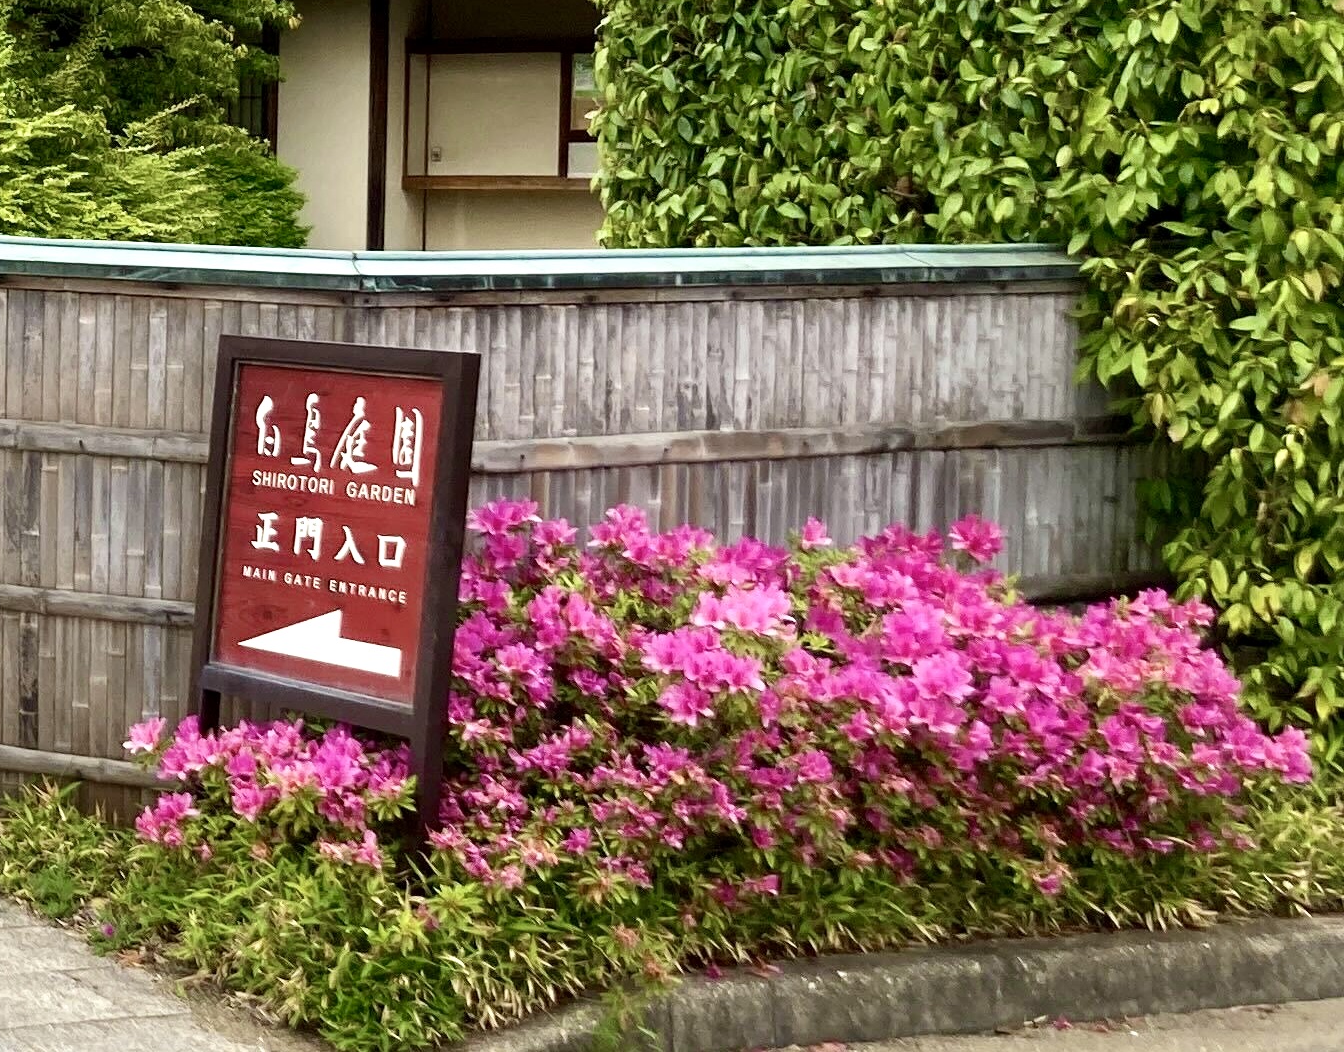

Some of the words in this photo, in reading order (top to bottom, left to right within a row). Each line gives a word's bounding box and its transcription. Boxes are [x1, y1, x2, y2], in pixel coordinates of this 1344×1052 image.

[255, 392, 424, 488] 白鳥庭園
[251, 469, 335, 495] SHIROTORI
[345, 481, 416, 507] GARDEN
[250, 511, 408, 569] 正門入口
[242, 564, 278, 582] MAIN
[283, 571, 321, 590] GATE
[329, 579, 408, 605] ENTRANCE
